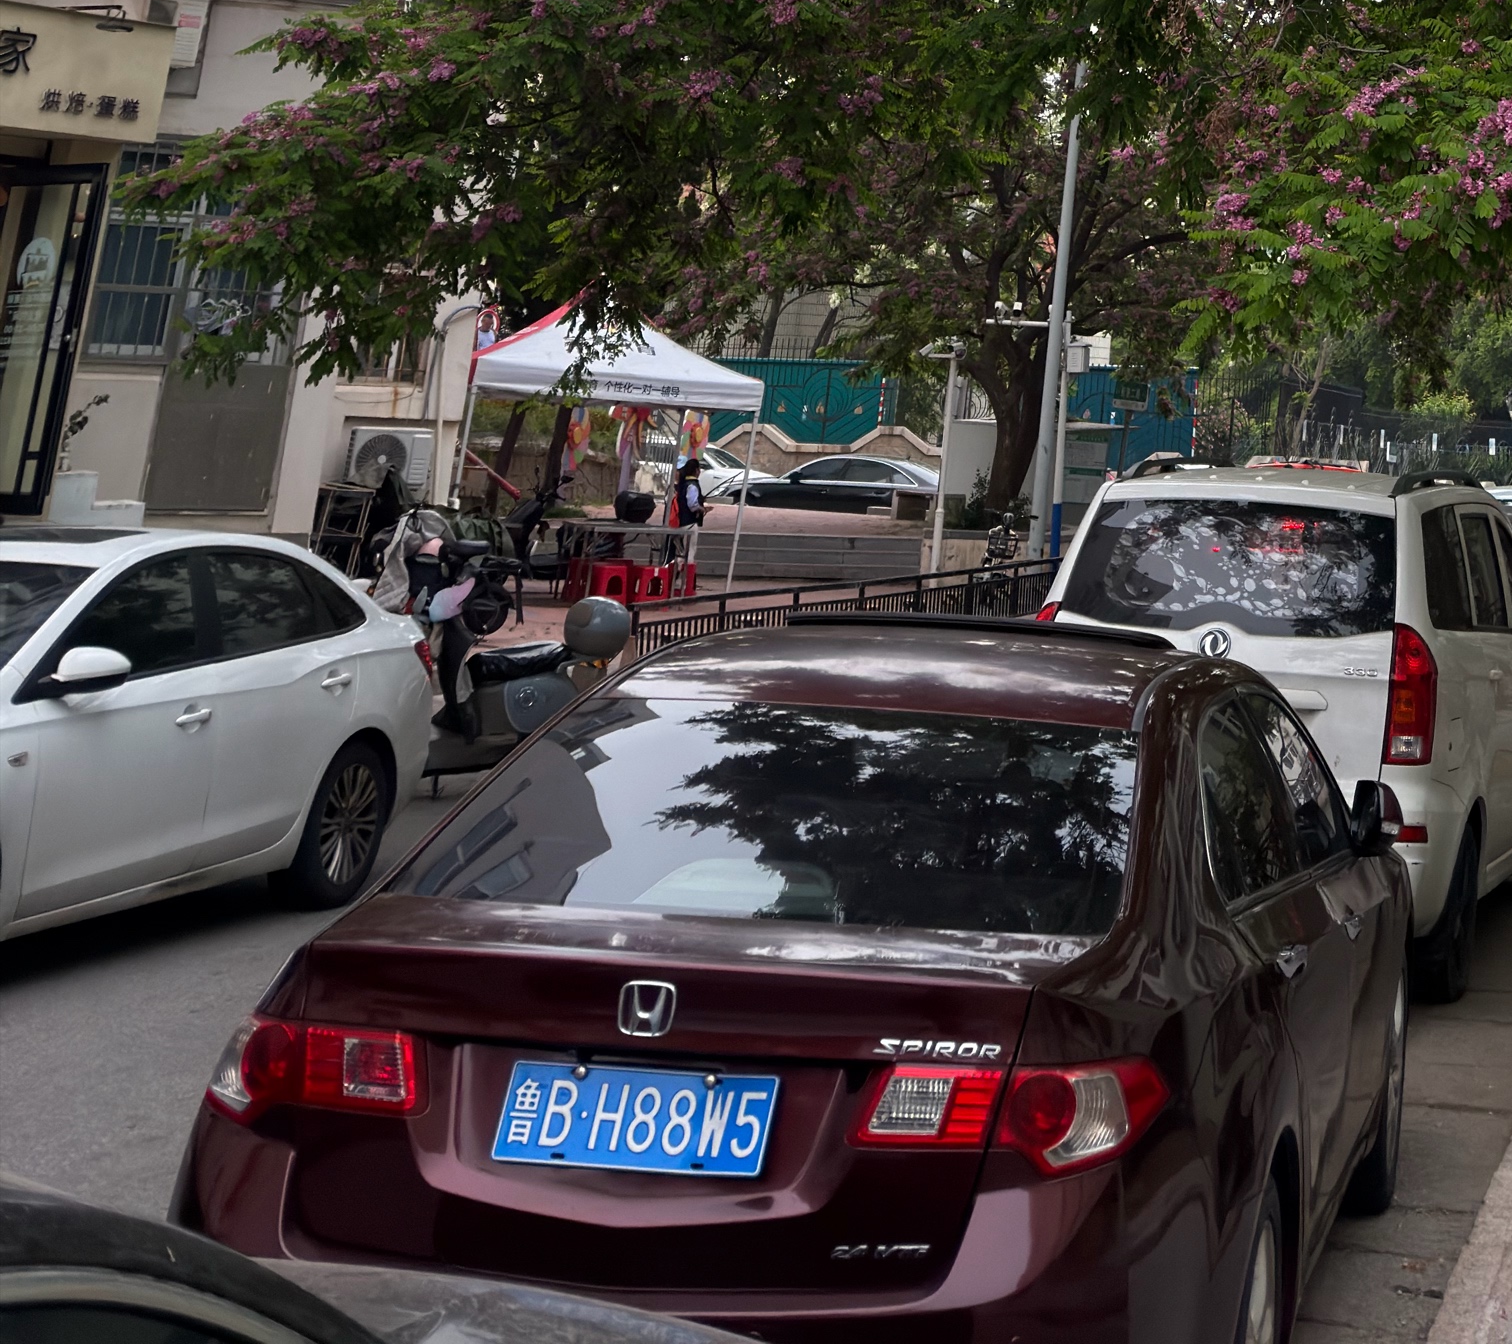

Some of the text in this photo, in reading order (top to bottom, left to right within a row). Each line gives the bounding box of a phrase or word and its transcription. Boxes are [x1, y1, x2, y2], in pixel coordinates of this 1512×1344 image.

[0, 27, 37, 74] 家
[1344, 666, 1378, 678] 330
[872, 1038, 1002, 1060] SPIROR
